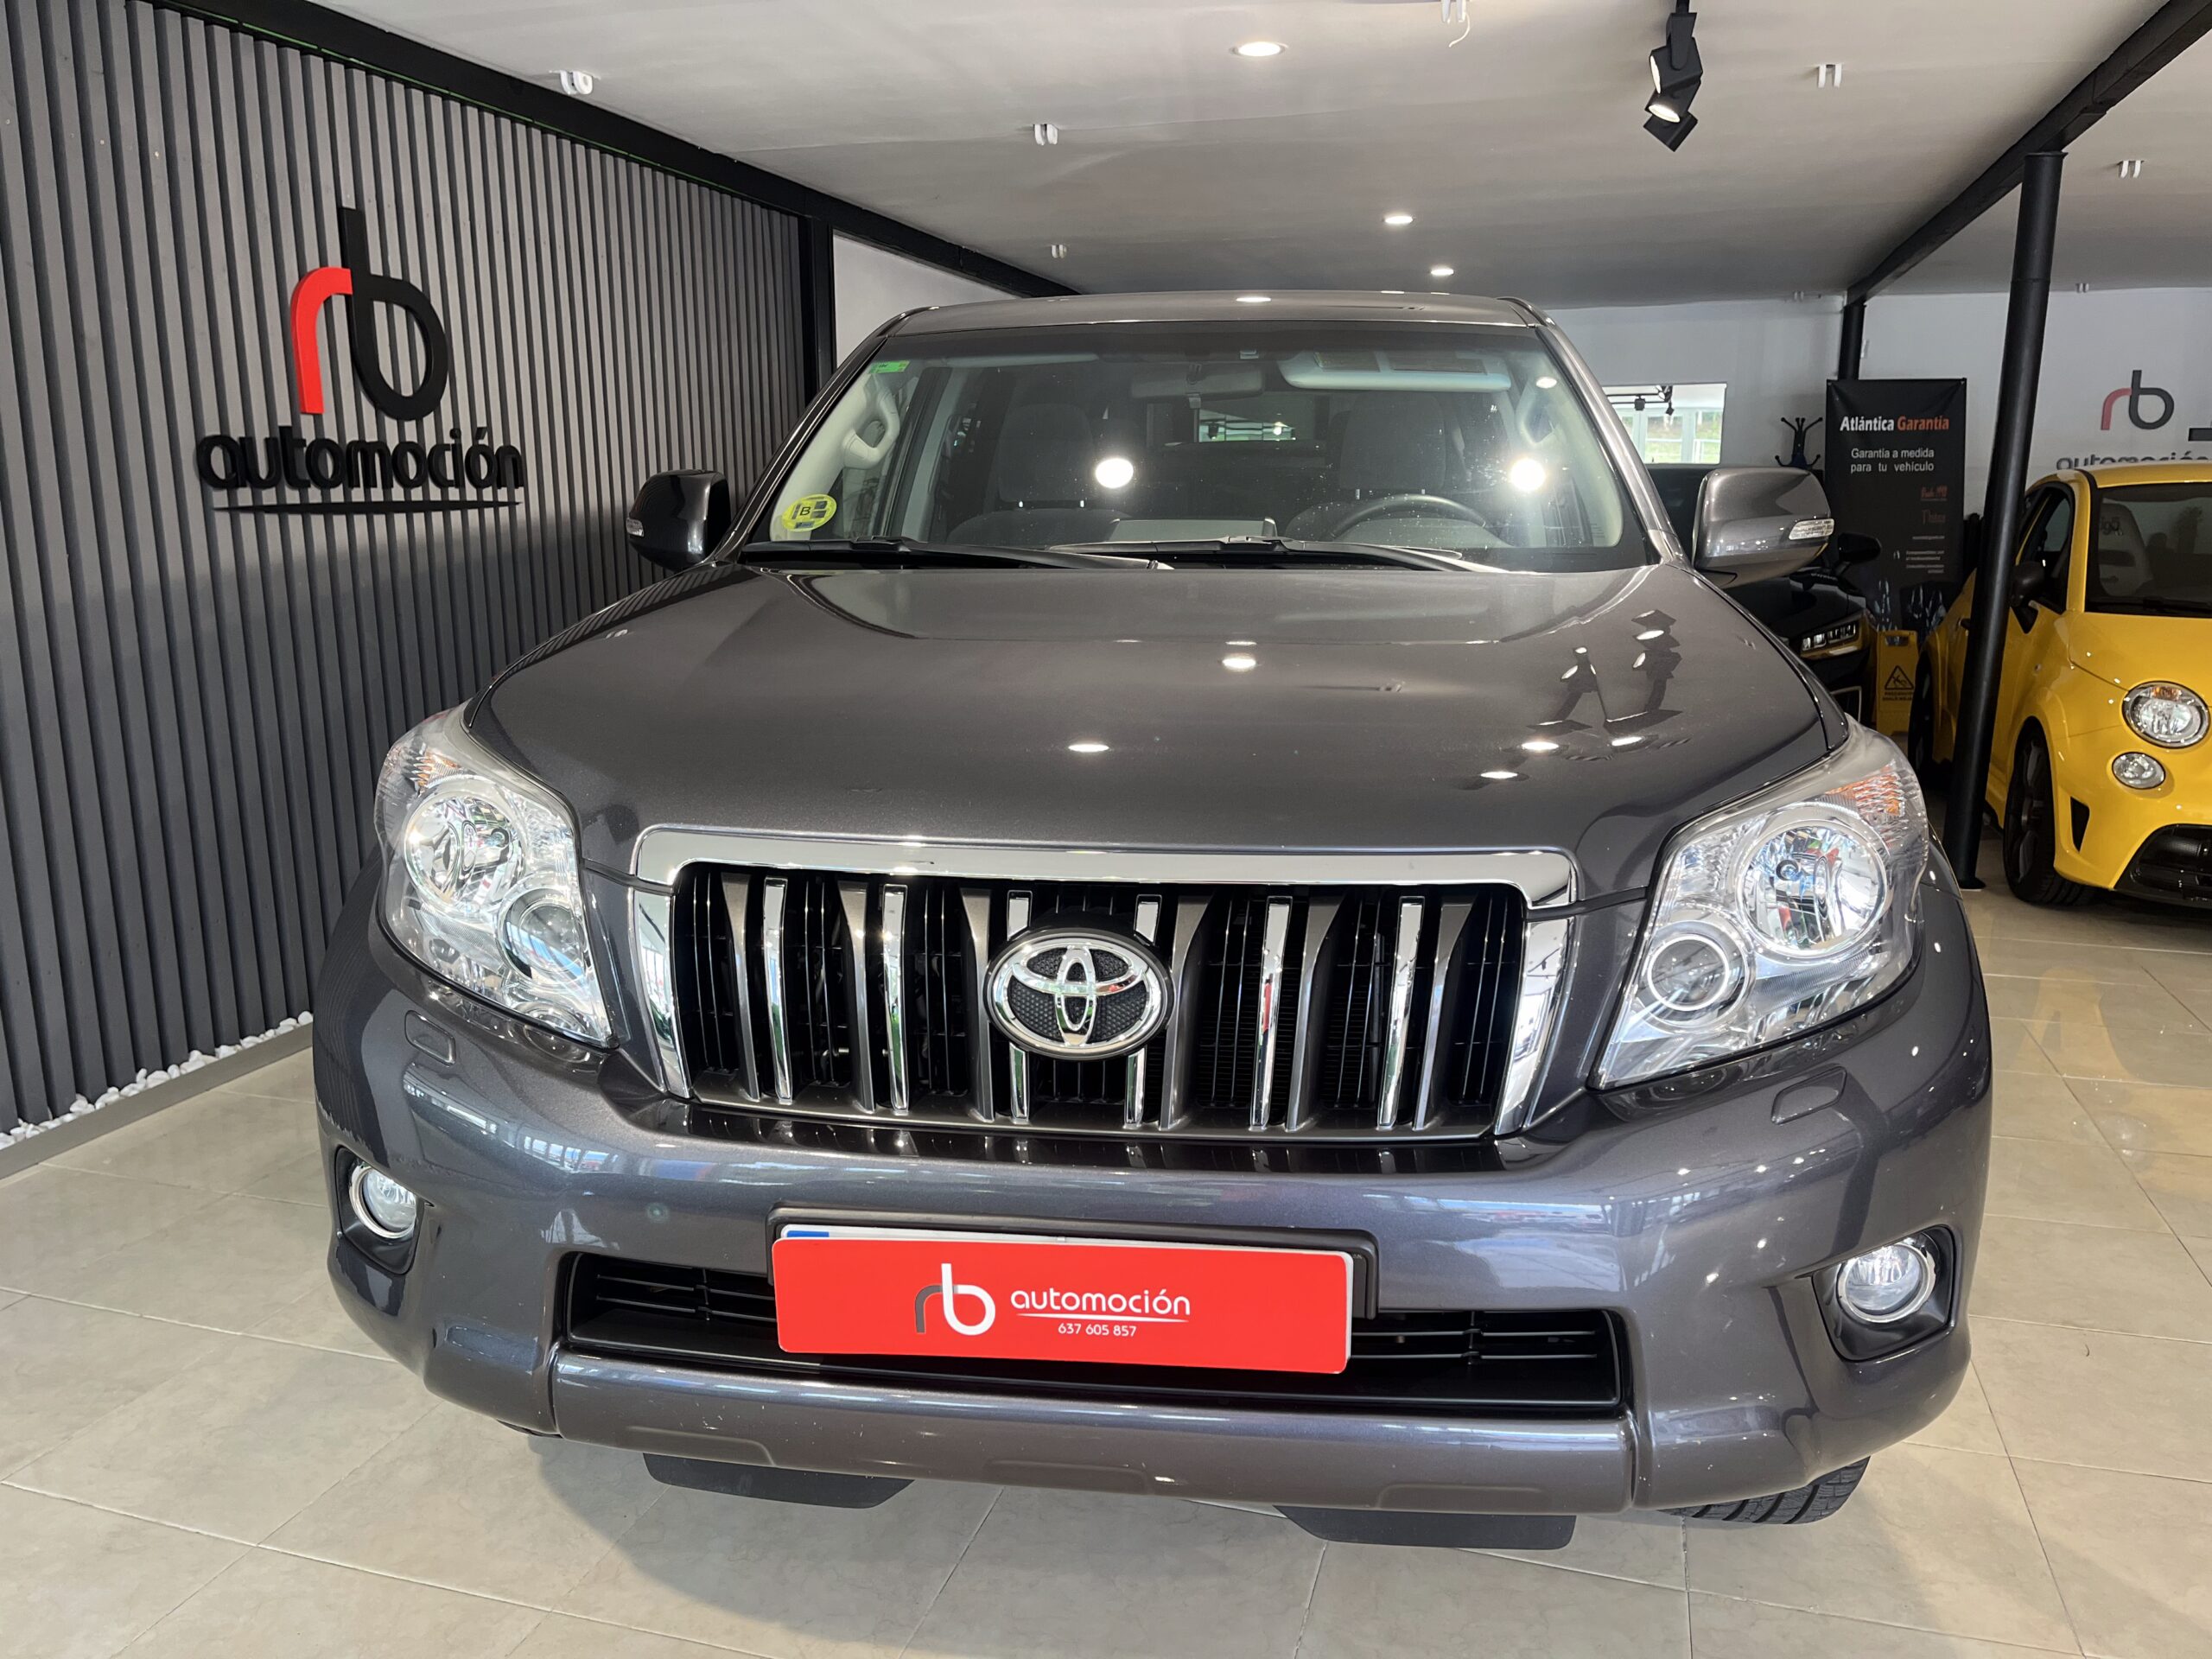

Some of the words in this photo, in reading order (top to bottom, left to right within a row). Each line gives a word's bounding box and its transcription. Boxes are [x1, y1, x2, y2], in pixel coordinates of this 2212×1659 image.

[290, 207, 448, 422] rb
[2101, 370, 2175, 430] rb
[1840, 416, 1894, 431] Atlántica
[196, 425, 524, 490] automoción
[1892, 450, 1898, 459] a
[1900, 448, 1935, 459] medida
[1850, 462, 1872, 474] para
[1878, 462, 1888, 472] tu
[1894, 461, 1935, 472] vehículo
[800, 506, 811, 516] B
[914, 1262, 996, 1336] rb
[1010, 1287, 1191, 1315] automoción
[1058, 1323, 1082, 1335] 637
[1085, 1324, 1109, 1336] 605
[1113, 1325, 1137, 1337] 857
